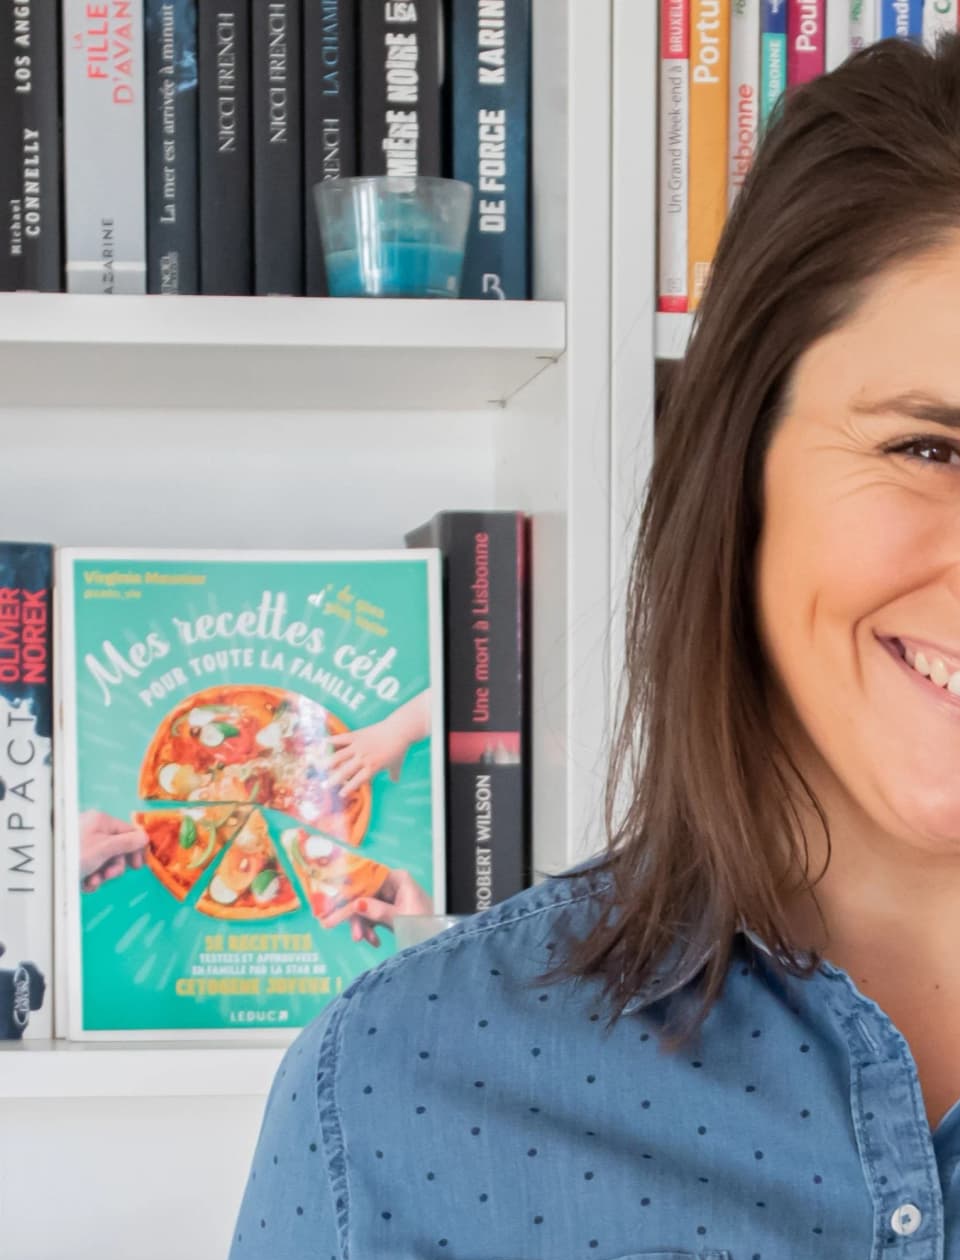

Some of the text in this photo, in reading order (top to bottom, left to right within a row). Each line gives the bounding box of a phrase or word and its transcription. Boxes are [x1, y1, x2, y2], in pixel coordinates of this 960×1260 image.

[15, 56, 31, 93] LOS
[87, 2, 109, 80] FILLE
[217, 12, 237, 152] NICCI FRENCH
[269, 3, 288, 142] NICCI FRENCH
[322, 72, 341, 97] LA
[157, 4, 177, 224] La mer est arrivée à minuit
[322, 118, 341, 190] RENCH
[382, 33, 419, 194] UMIÈRE NOIRE
[477, 0, 507, 233] DE FORCE KARIN
[667, 75, 682, 147] Week-end
[24, 128, 40, 236] CONNELLY
[668, 149, 682, 191] Grand
[668, 197, 682, 214] Un
[102, 219, 114, 295] AZARINE
[23, 588, 47, 683] NOREK
[85, 632, 171, 707] Mes
[173, 590, 326, 655] recettes
[333, 643, 402, 702] céto
[471, 532, 490, 723] Une mort à Lisbonne
[138, 648, 367, 712] POUR TOUTE LA FAMILLE
[7, 712, 35, 894] IMPACT
[476, 775, 493, 910] ROBERT WILSON
